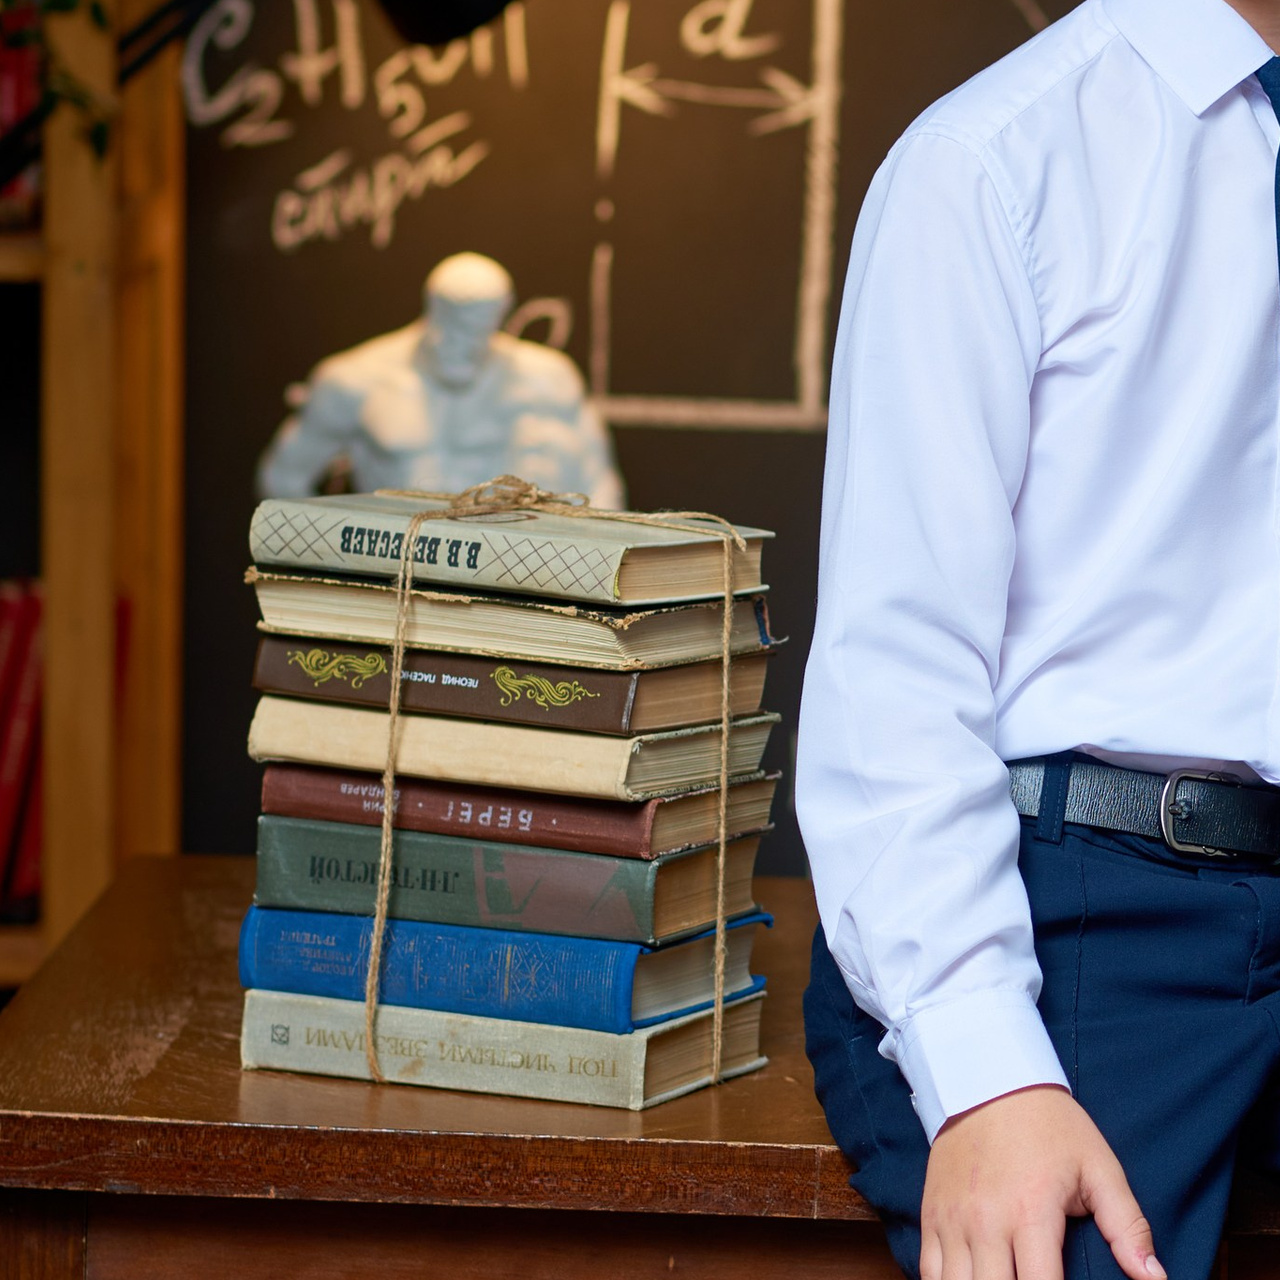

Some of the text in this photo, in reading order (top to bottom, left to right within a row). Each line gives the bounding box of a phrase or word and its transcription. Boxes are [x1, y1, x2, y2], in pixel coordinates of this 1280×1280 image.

[340, 525, 441, 565] ВЕЕСАЕВ
[340, 783, 401, 801] БНДАРЕВ
[438, 1040, 558, 1072] ЧИСТЫМИ
[568, 1055, 619, 1079] ПОД
